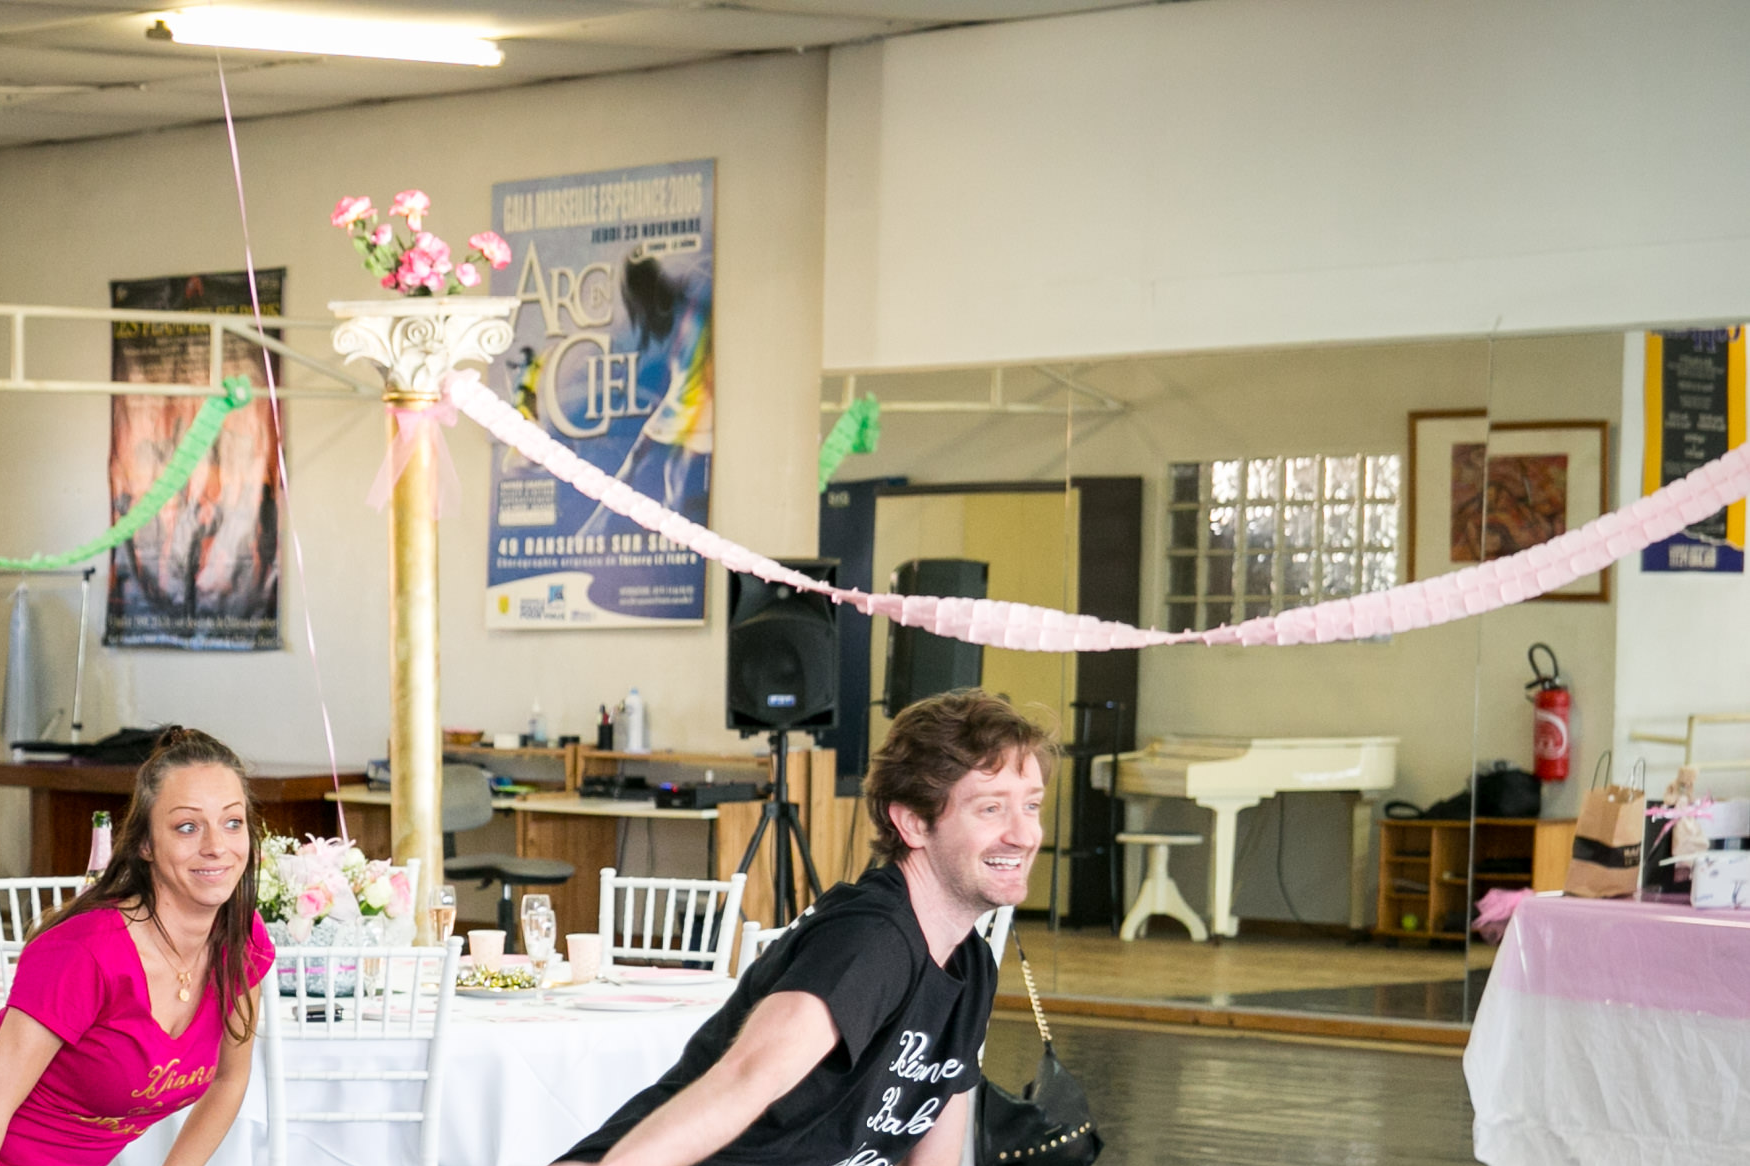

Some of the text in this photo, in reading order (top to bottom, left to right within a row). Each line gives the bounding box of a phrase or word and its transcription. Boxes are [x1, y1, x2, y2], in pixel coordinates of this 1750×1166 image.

[503, 192, 534, 234] GALA
[535, 184, 597, 229] MARSEILLE
[591, 217, 701, 244] JEUDI 23 NOVEMBRE
[511, 240, 612, 337] ARC
[546, 332, 652, 438] CIEL
[525, 536, 605, 556] DANSEURS
[612, 534, 642, 553] SUR
